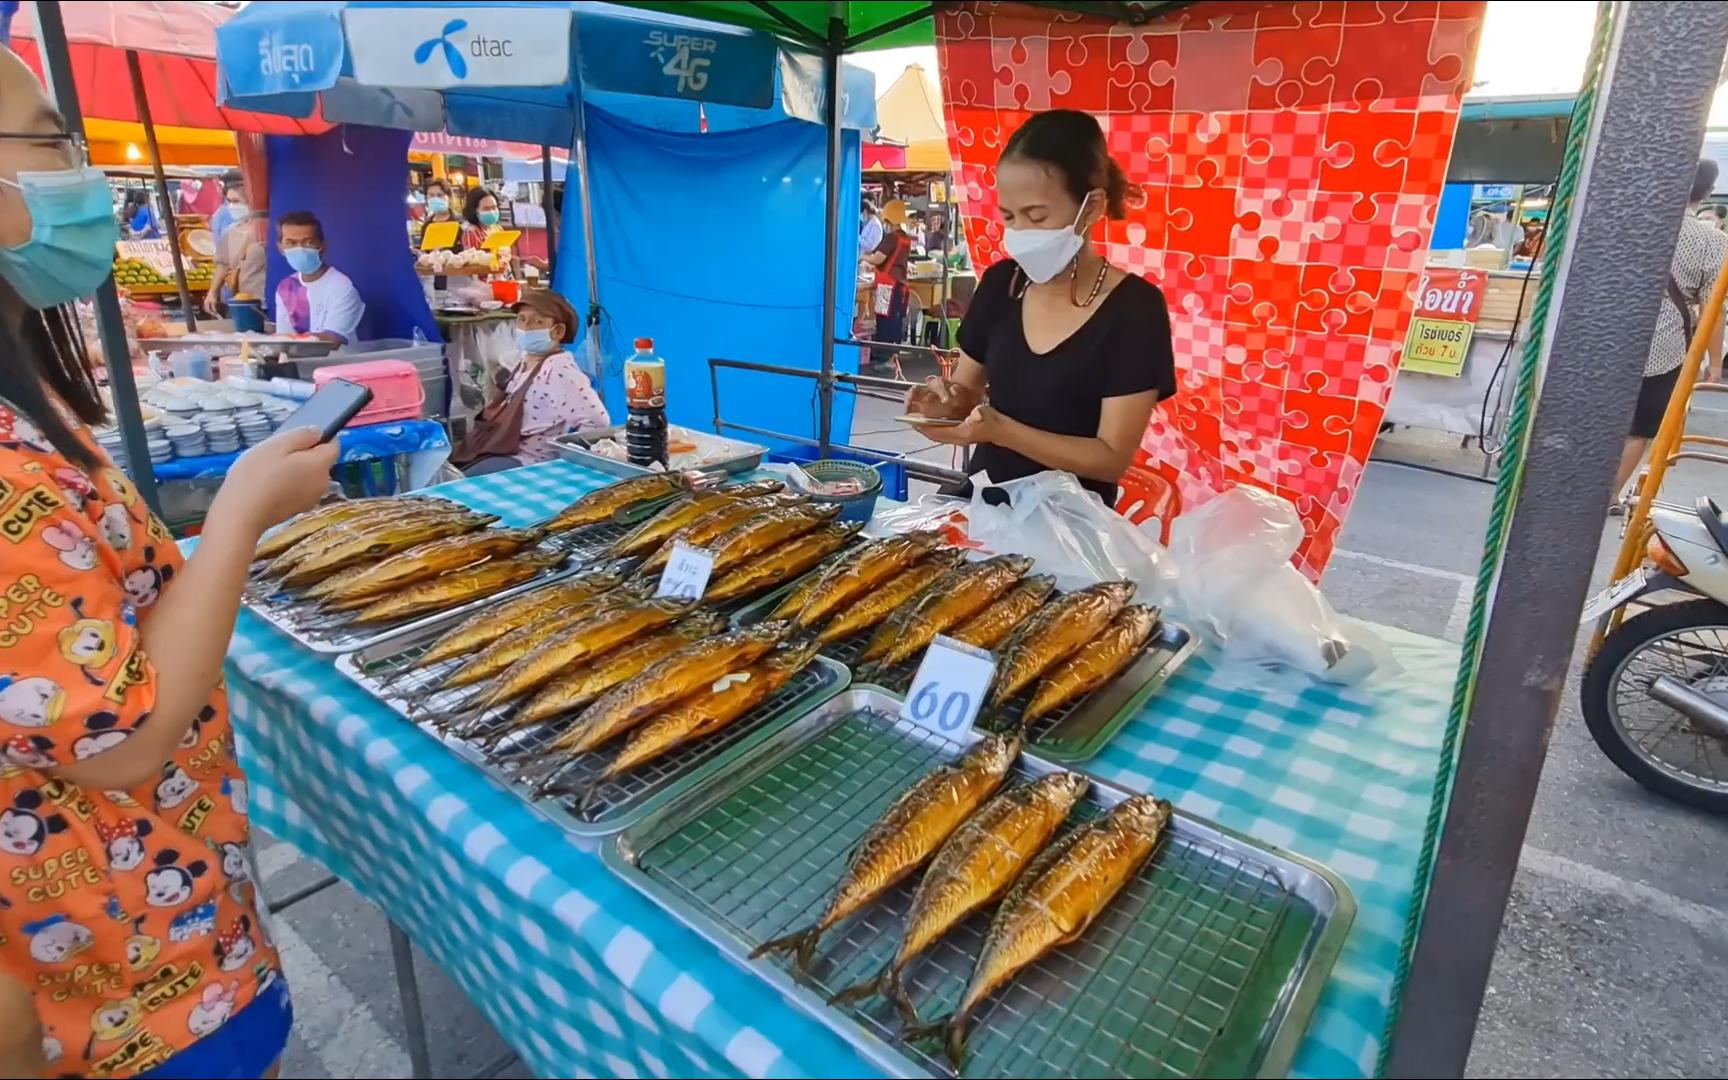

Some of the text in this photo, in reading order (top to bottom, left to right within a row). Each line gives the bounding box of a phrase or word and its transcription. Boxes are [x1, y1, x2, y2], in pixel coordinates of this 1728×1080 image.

[470, 34, 513, 57] dtac
[643, 30, 717, 53] SUPER
[662, 46, 711, 93] 4G
[1440, 345, 1448, 357] 7
[3, 490, 60, 536] CUTE
[0, 587, 64, 648] CUTE
[910, 681, 970, 732] 60
[182, 799, 212, 831] UTE
[27, 866, 100, 902] CUTE
[148, 963, 202, 1006] CUTE
